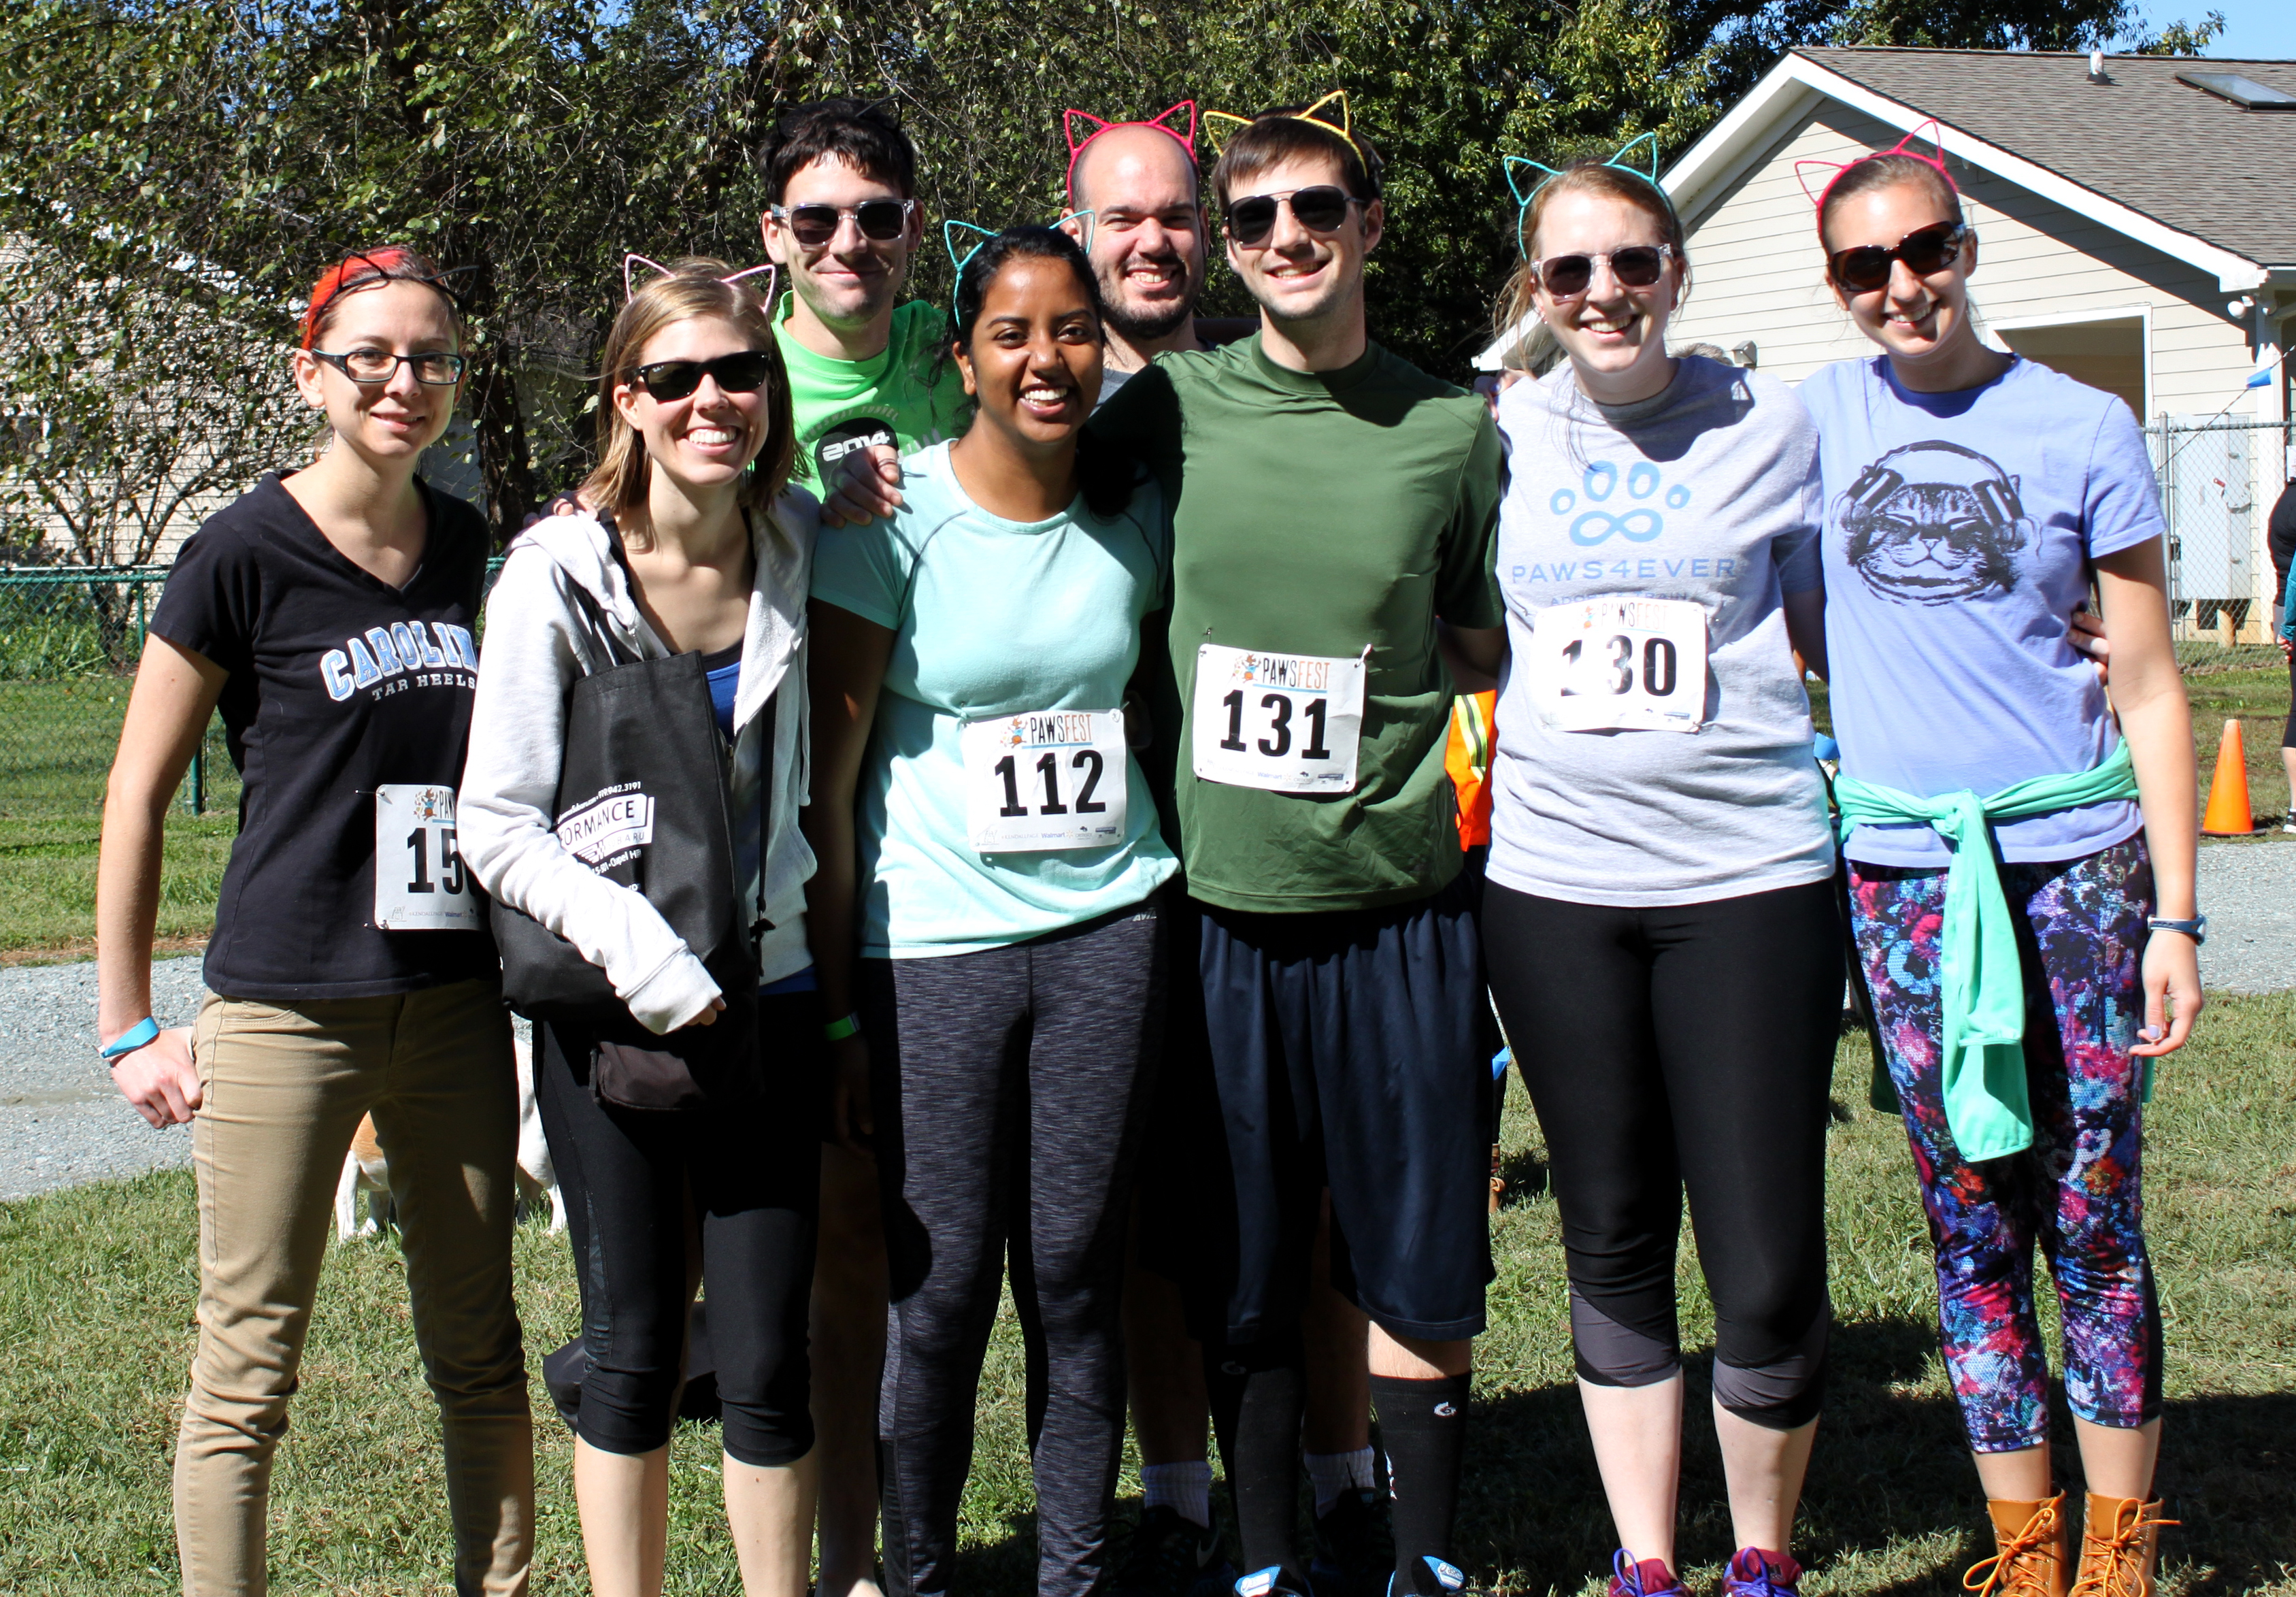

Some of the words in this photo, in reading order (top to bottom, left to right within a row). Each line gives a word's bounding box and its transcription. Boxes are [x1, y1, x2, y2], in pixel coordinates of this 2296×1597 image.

[822, 429, 891, 462] 2014
[1512, 559, 1735, 584] PAWS4EVER
[1601, 602, 1669, 629] PWSFEST
[320, 620, 478, 702] CAROLIN
[1263, 657, 1330, 689] PAWSFEST
[372, 678, 409, 702] TAR
[416, 673, 476, 689] HEELS
[1030, 714, 1092, 744] PAWSFEST
[1220, 689, 1331, 760] 131
[995, 749, 1106, 817] 112
[559, 800, 635, 845] FORMANCE
